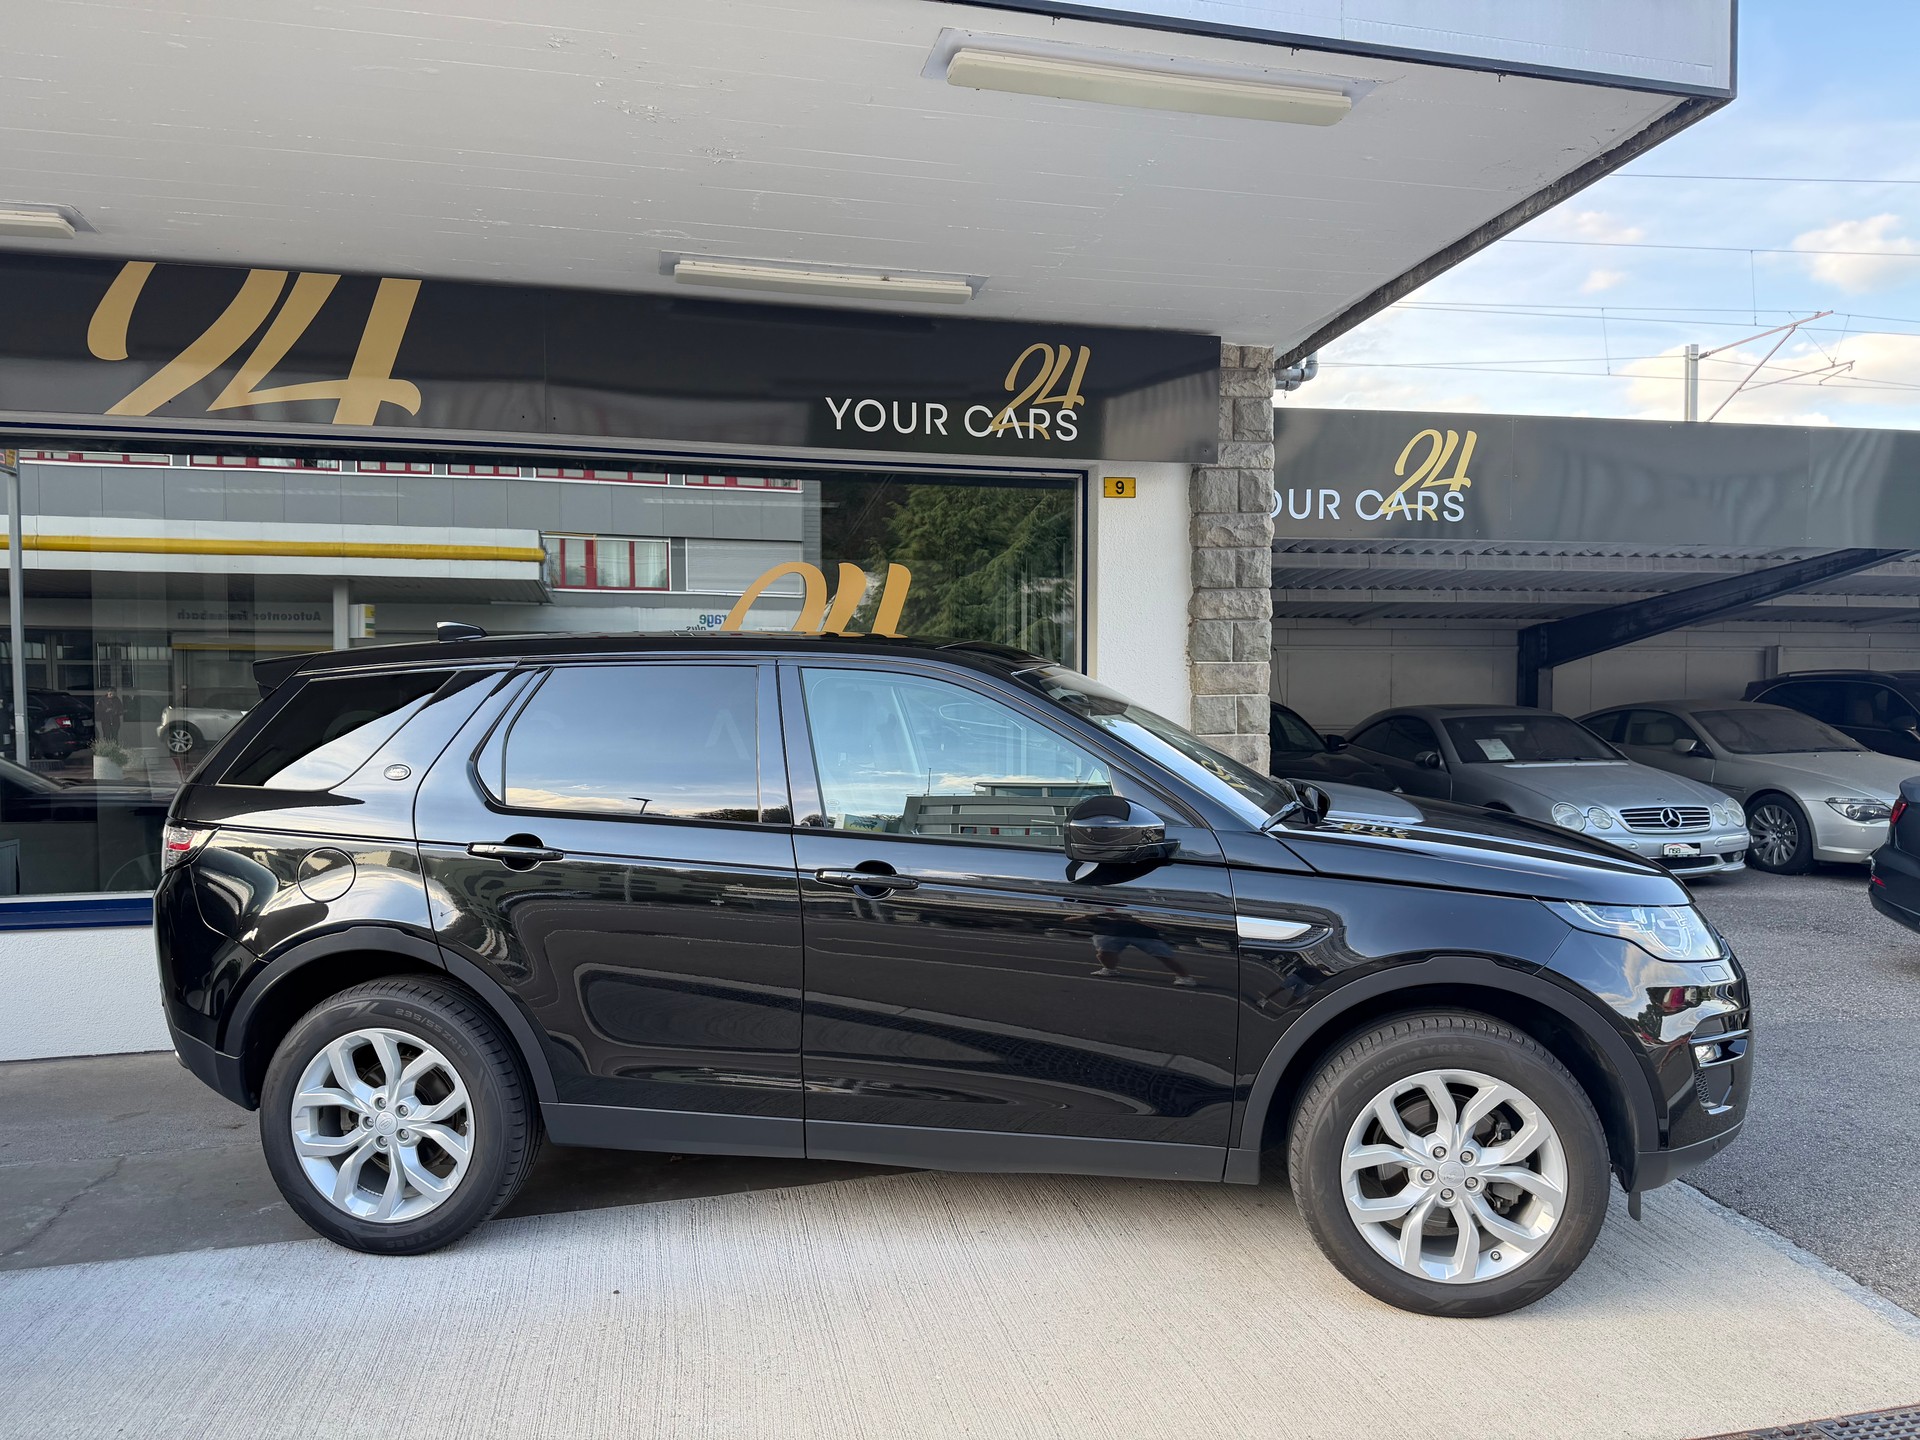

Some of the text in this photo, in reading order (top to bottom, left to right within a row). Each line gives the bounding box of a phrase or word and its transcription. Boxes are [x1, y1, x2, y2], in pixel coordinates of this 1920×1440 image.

[990, 342, 1091, 440] 24
[826, 397, 1078, 441] YOUR CARS
[1115, 480, 1125, 495] 9
[1380, 428, 1478, 521] 24
[1355, 488, 1465, 522] CARS
